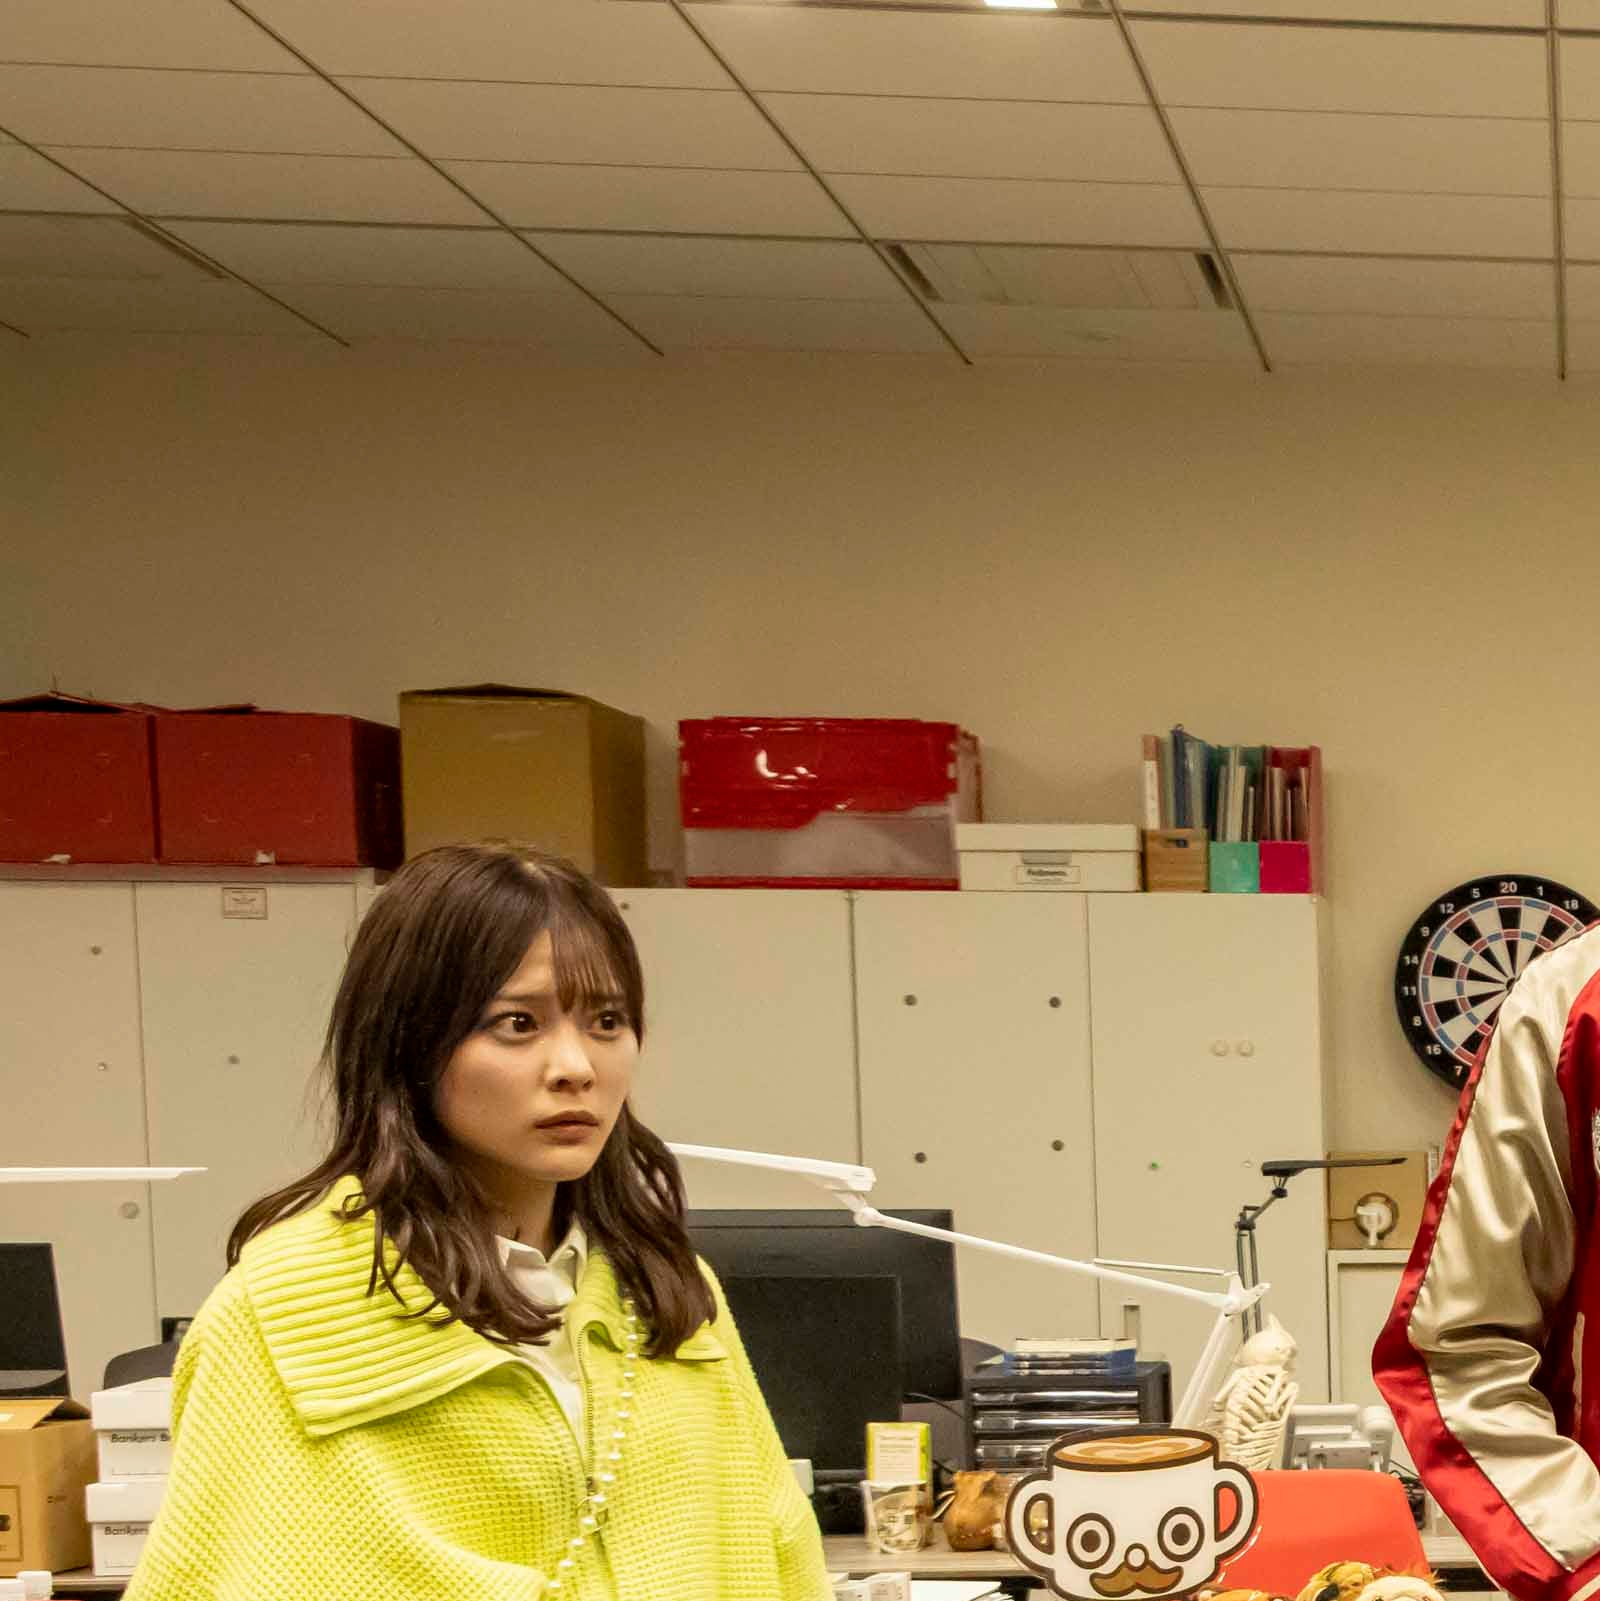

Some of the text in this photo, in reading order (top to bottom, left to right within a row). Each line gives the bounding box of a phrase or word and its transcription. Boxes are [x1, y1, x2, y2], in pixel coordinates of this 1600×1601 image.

[1501, 882, 1517, 893] 20
[1537, 886, 1543, 895] 1
[1473, 888, 1480, 898] 5
[1440, 904, 1454, 914] 12
[1564, 900, 1579, 910] 18
[1421, 927, 1429, 936] 9
[1404, 956, 1419, 965] 14
[1403, 986, 1416, 996] 11
[1426, 1045, 1441, 1055] 16
[1455, 1065, 1463, 1076] 7
[111, 1433, 157, 1443] Bankers
